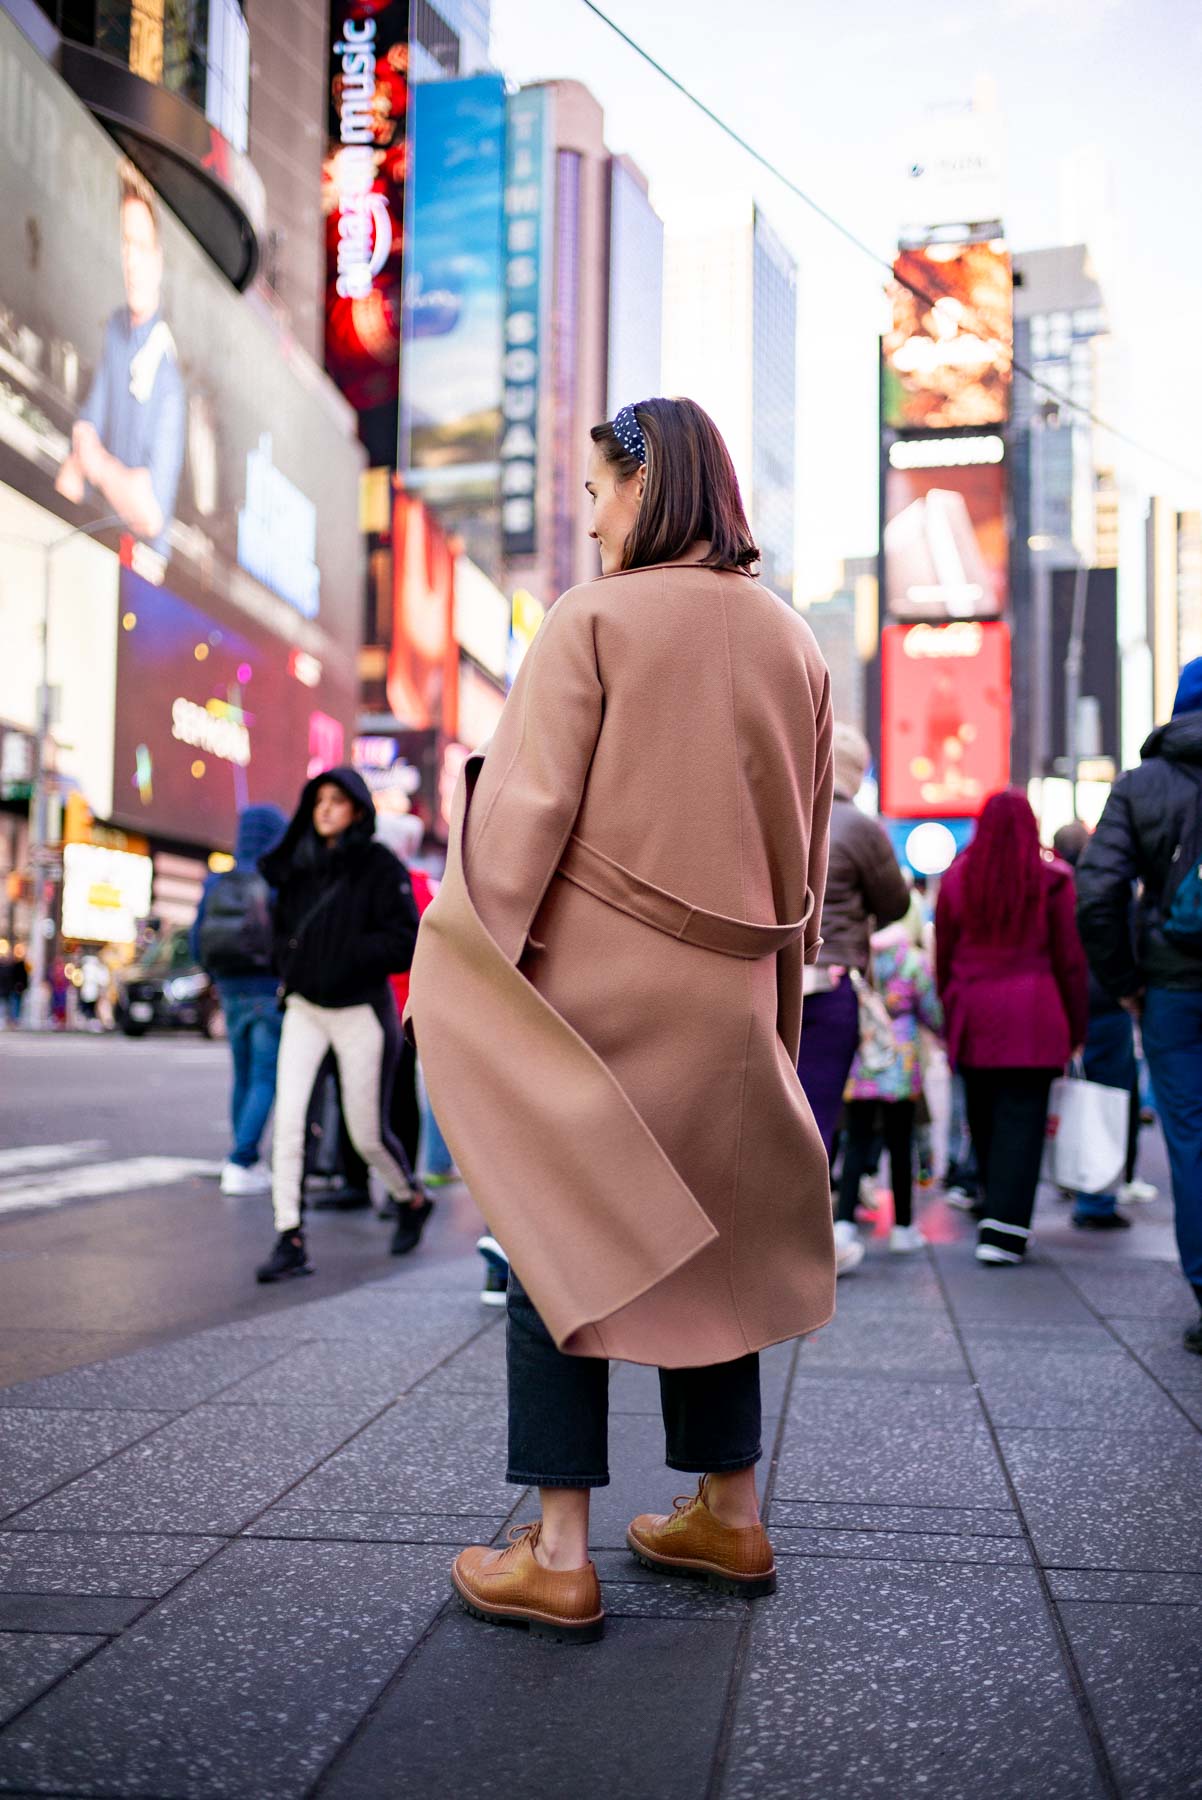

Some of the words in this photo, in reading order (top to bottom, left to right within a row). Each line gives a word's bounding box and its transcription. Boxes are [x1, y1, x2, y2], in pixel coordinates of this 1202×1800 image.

[333, 18, 376, 144] music
[336, 146, 374, 298] amazn
[501, 311, 536, 533] SQUARE
